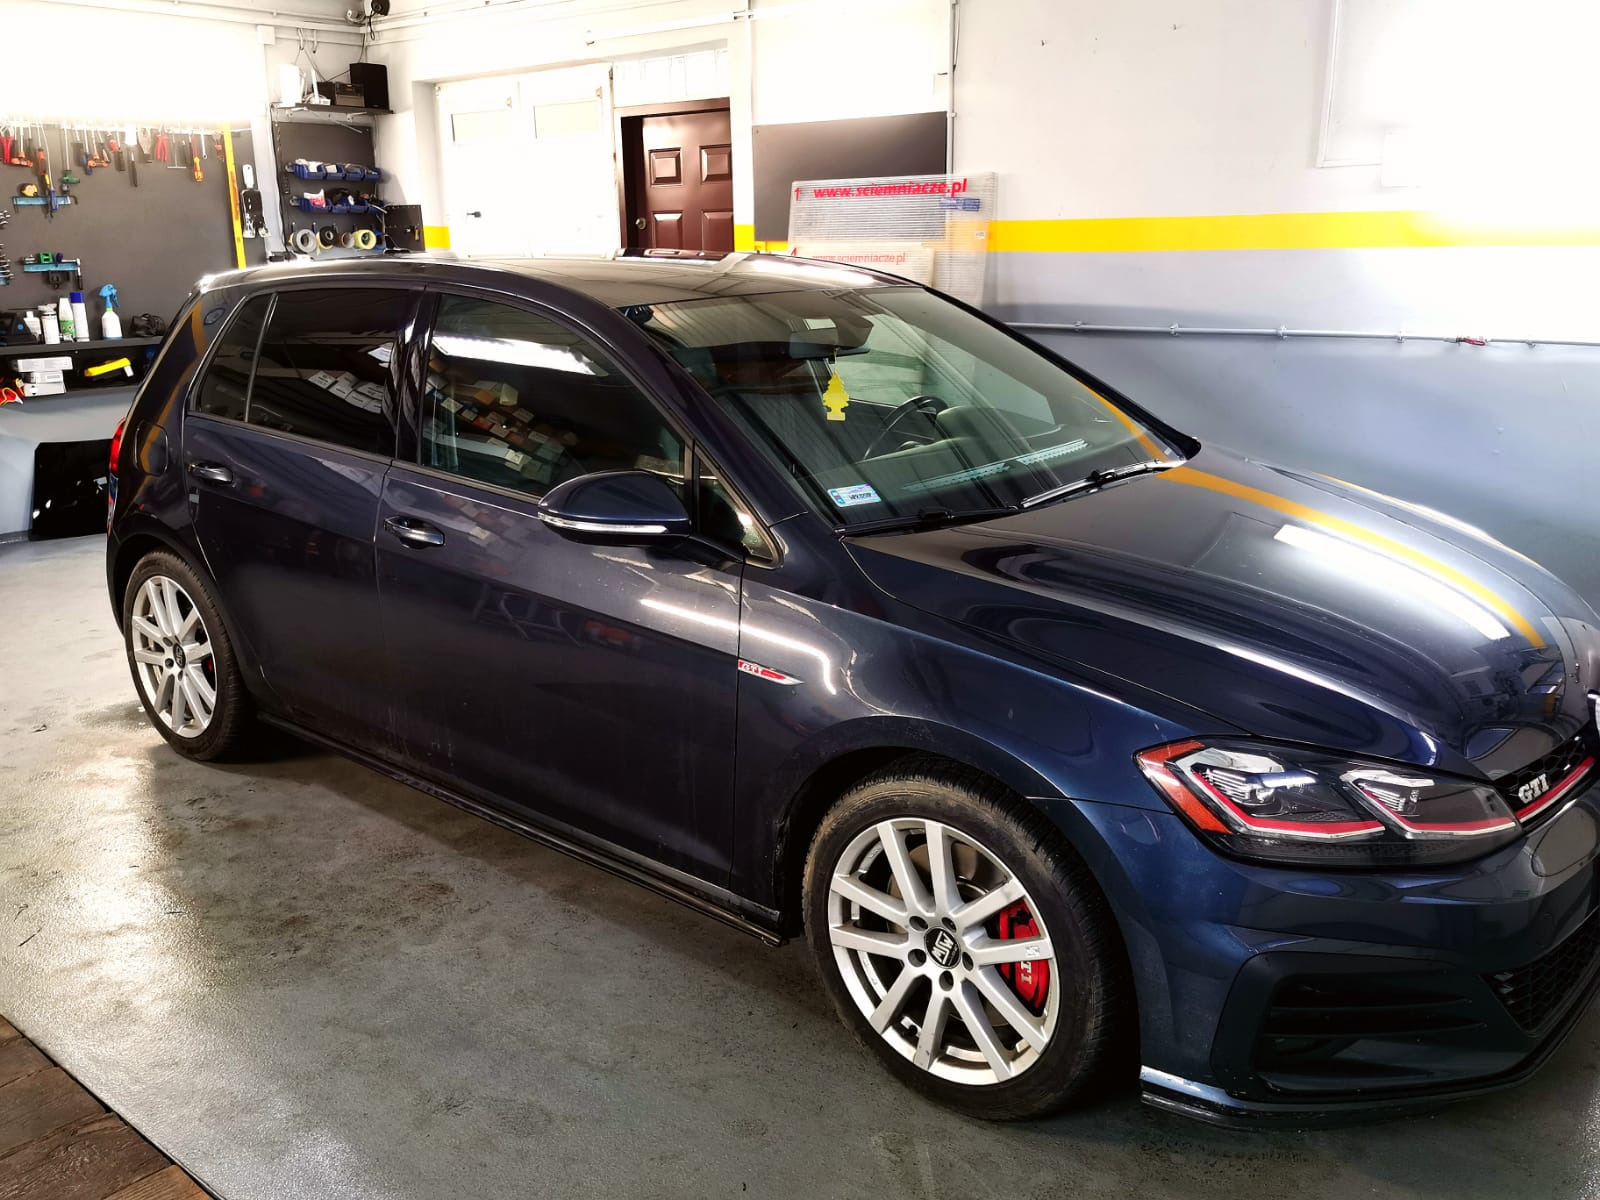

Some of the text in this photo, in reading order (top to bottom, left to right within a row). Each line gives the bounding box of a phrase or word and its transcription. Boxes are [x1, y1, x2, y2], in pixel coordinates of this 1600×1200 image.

[813, 178, 968, 199] www.sciemniacze.pl
[1518, 773, 1550, 804] GTI
[931, 930, 954, 965] MSW
[1020, 960, 1032, 985] TI
